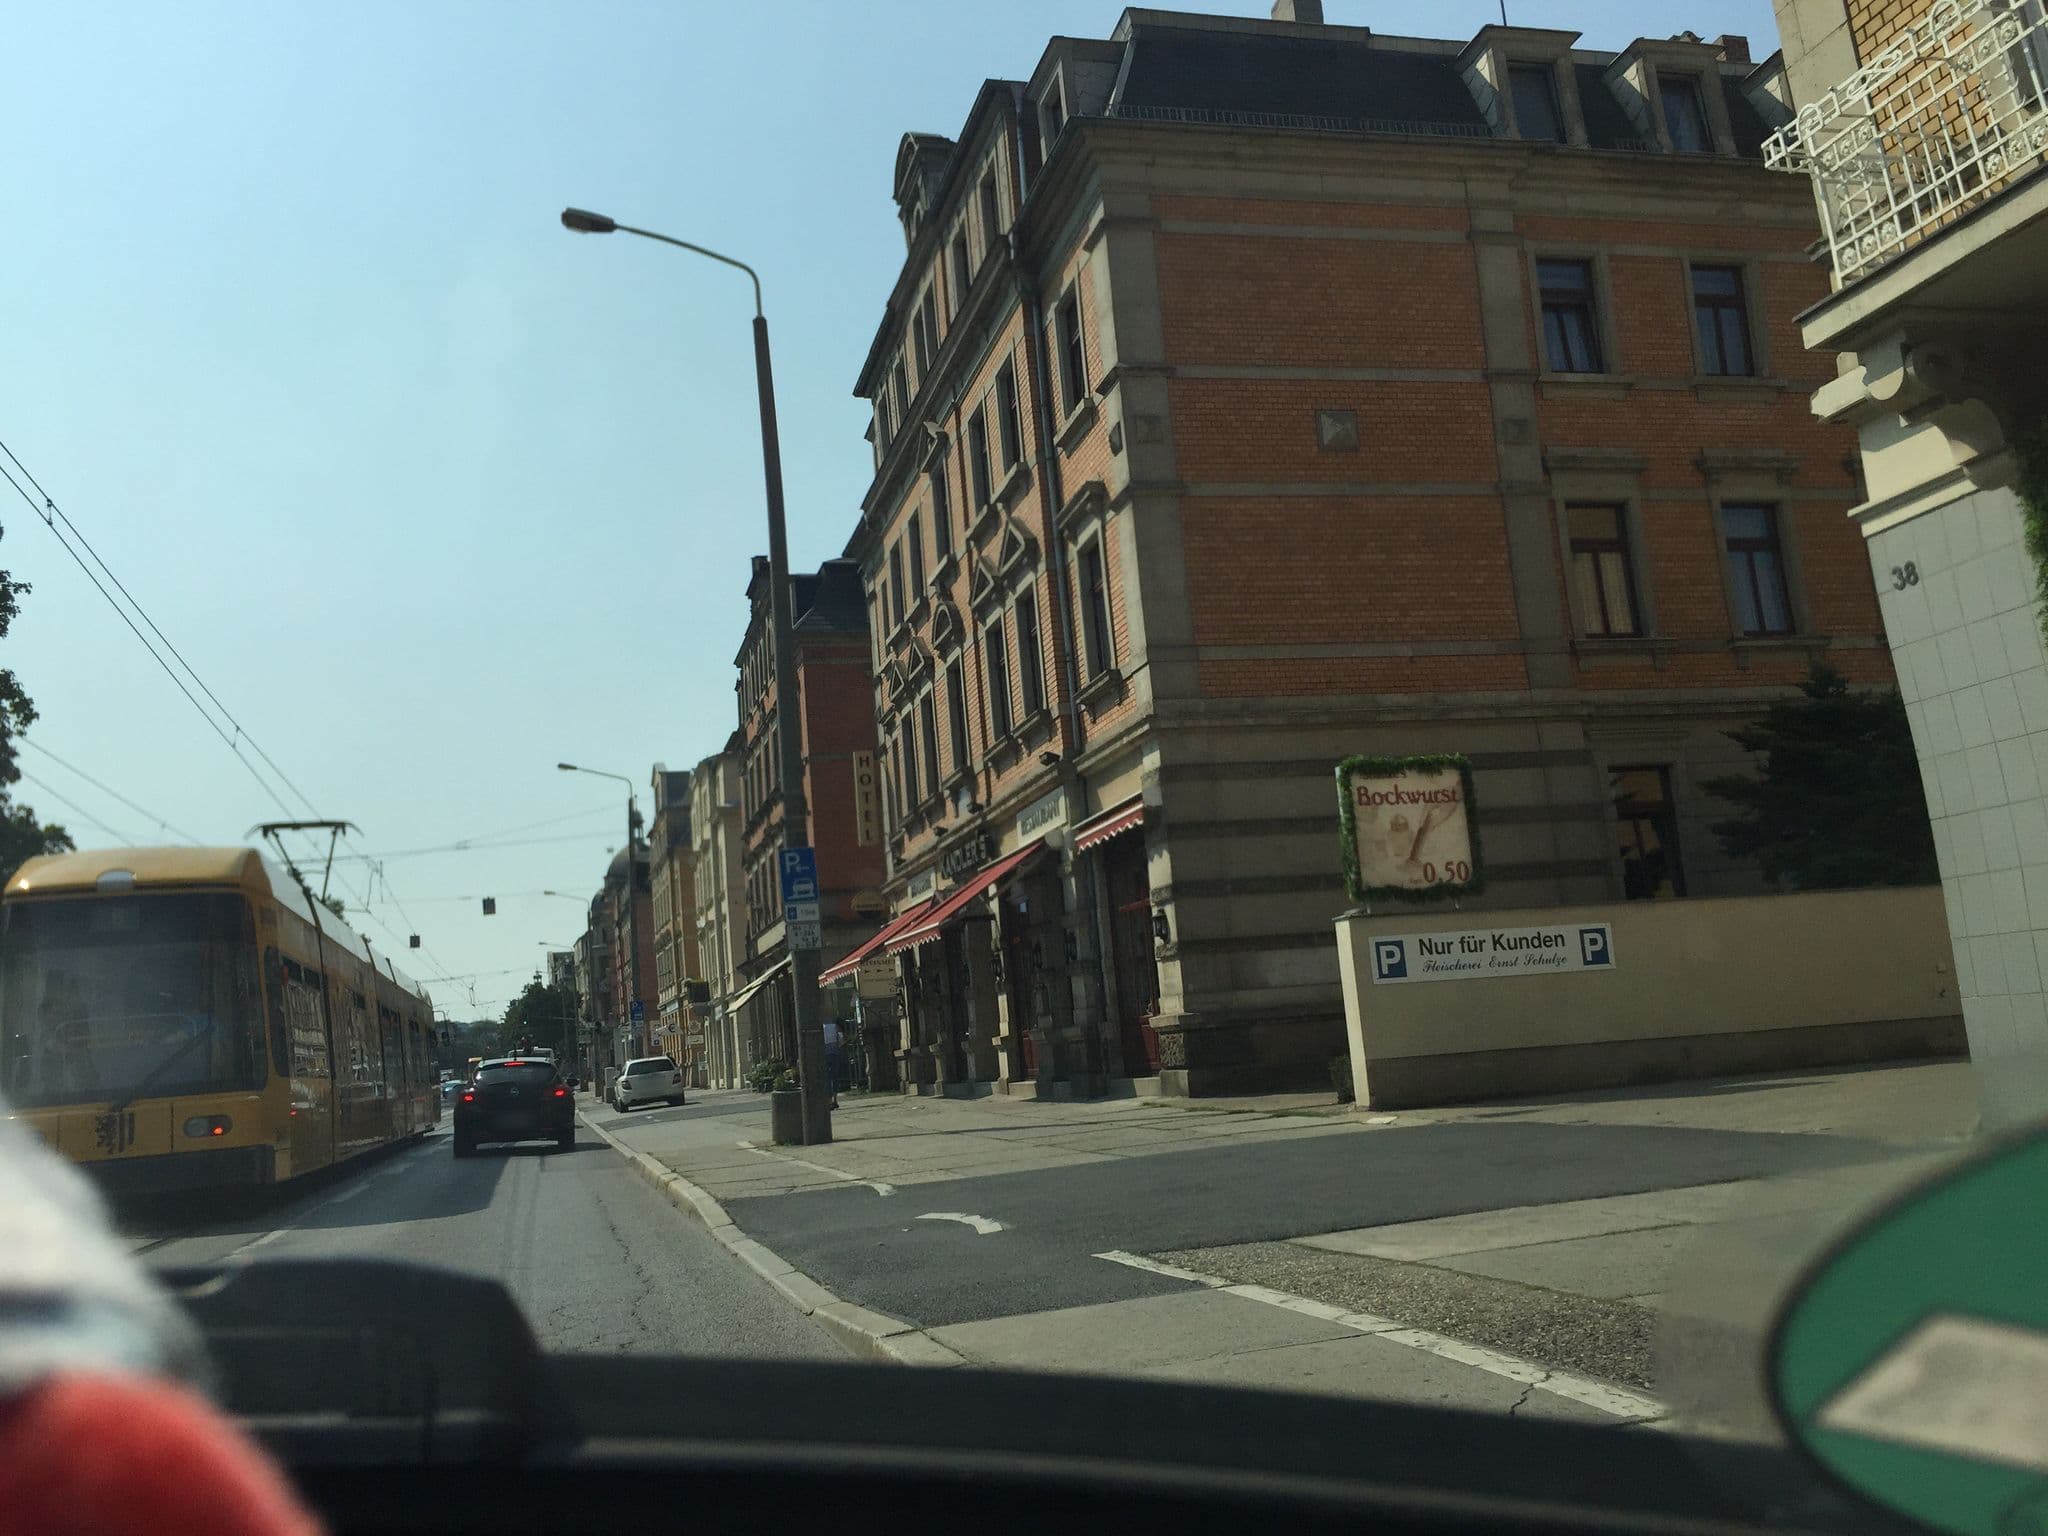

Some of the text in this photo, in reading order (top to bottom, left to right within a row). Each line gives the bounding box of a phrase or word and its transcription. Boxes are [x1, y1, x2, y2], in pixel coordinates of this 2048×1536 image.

[1891, 560, 1919, 591] 38
[859, 755, 873, 841] HOTEL
[1356, 783, 1458, 807] Bockwurst
[783, 852, 800, 874] P
[1418, 931, 1566, 956] Nur für Kunden
[1585, 932, 1604, 962] P
[1378, 944, 1401, 975] P
[1422, 952, 1568, 973] Fleischerei Ernst Schulze
